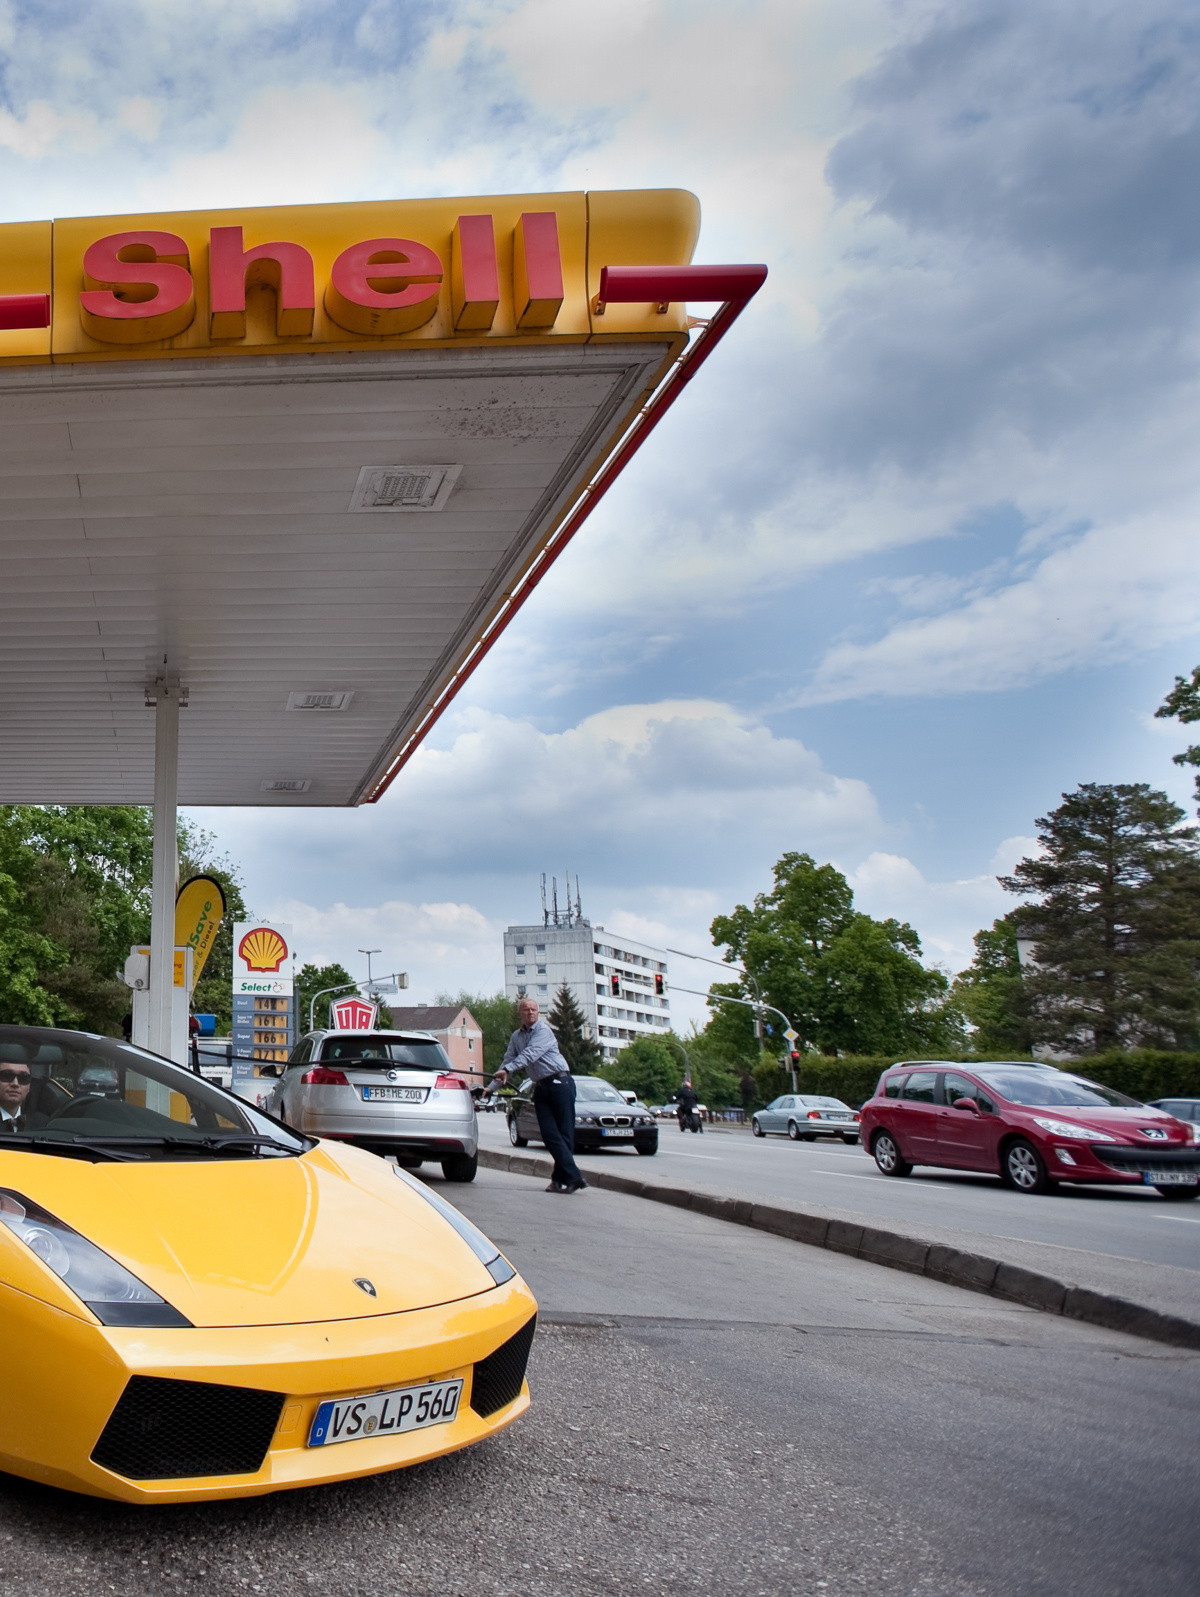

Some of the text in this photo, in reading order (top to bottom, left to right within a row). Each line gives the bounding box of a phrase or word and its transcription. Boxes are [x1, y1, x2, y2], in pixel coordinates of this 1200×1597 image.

[79, 211, 565, 330] Shell
[200, 920, 215, 949] Diesel
[240, 982, 271, 992] Select
[259, 1016, 276, 1027] 161
[258, 1033, 276, 1044] 166
[369, 1088, 421, 1099] FFB ME 200
[332, 1402, 367, 1438] VS
[378, 1393, 413, 1431] LP
[416, 1386, 459, 1423] 560
